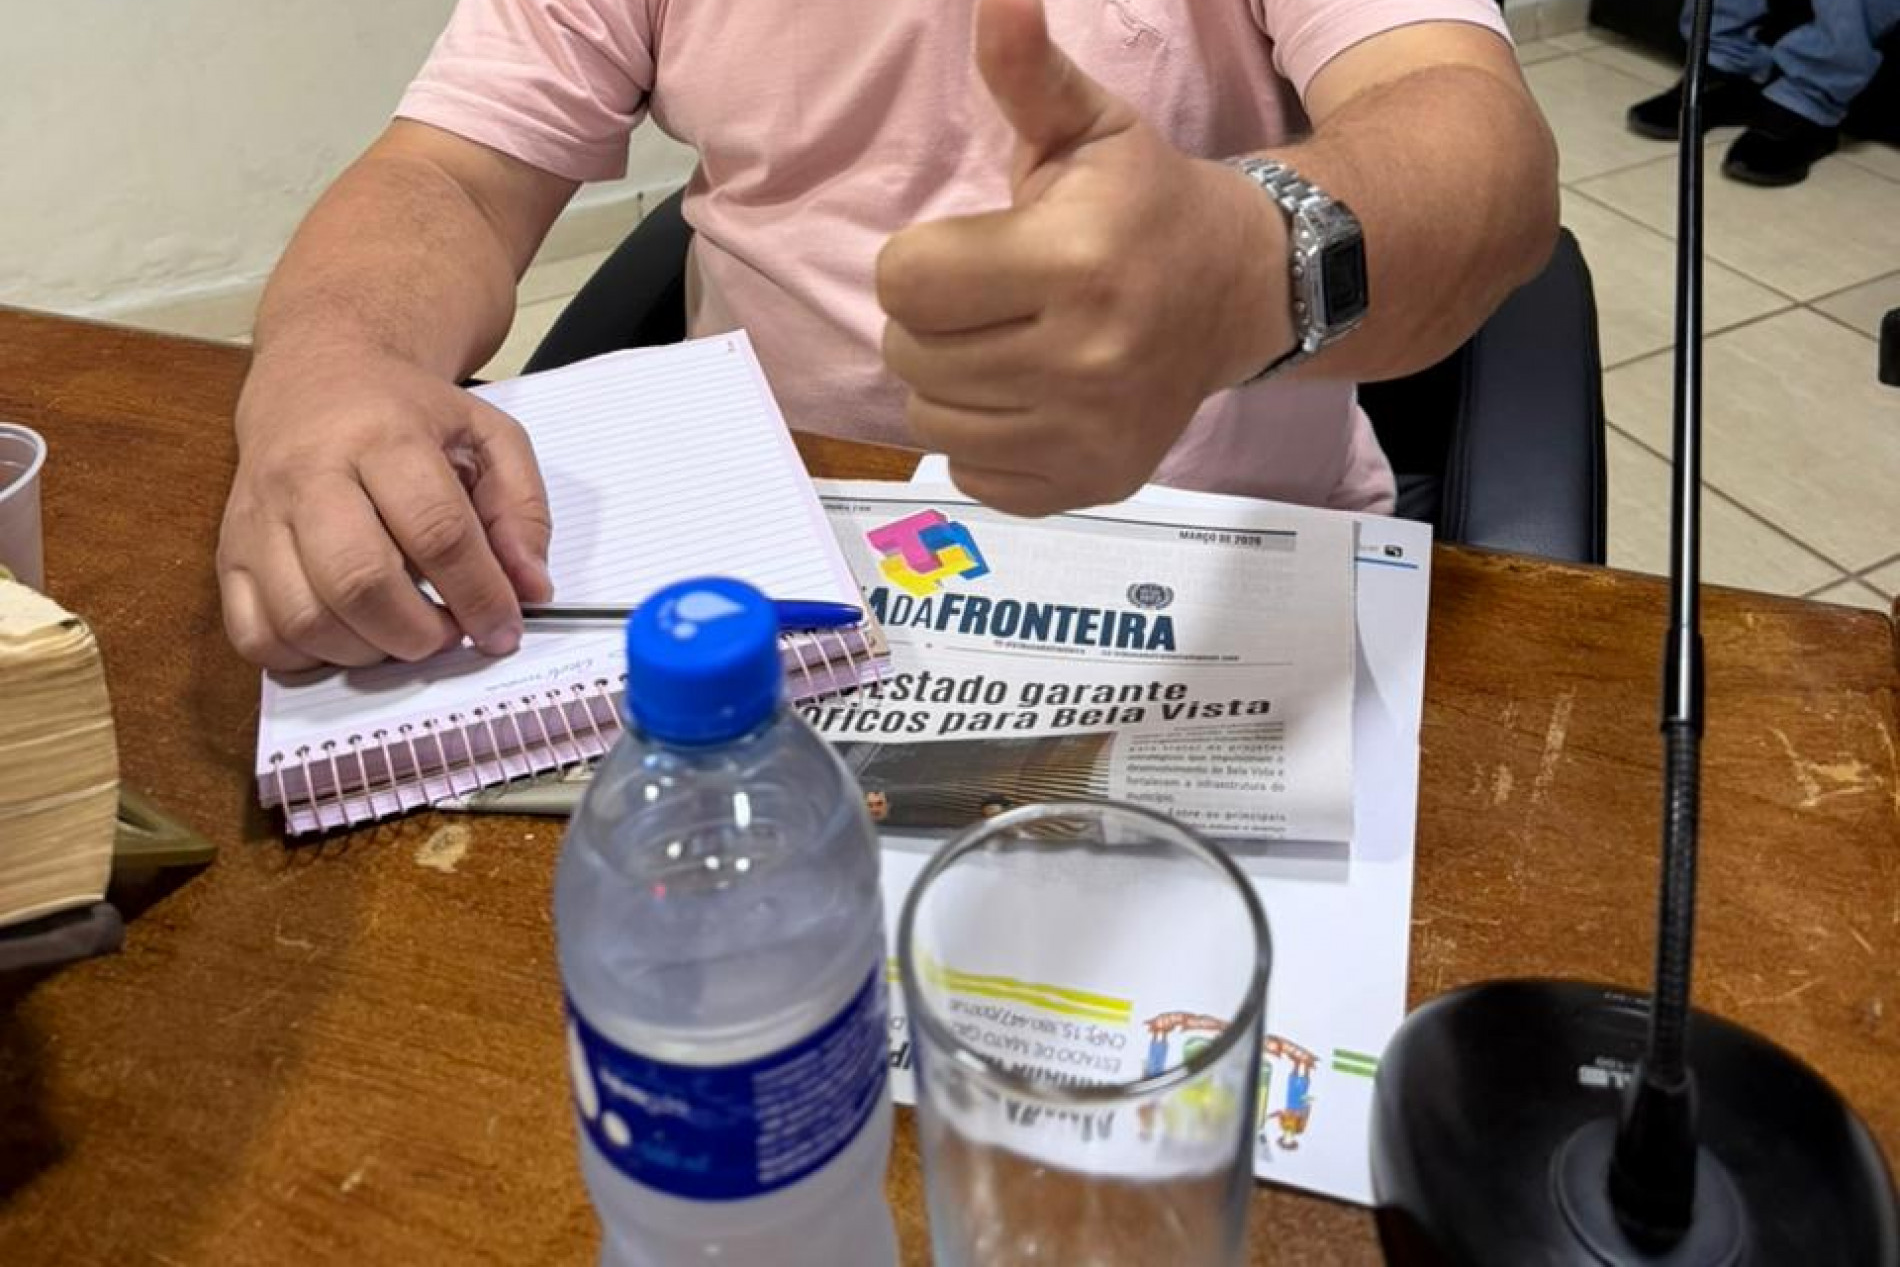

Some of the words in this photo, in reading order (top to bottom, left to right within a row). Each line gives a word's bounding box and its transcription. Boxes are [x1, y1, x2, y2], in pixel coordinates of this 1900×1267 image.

[1018, 680, 1188, 708] garante
[937, 710, 1039, 736] para
[1051, 706, 1146, 729] Bela
[1162, 699, 1271, 721] Vista
